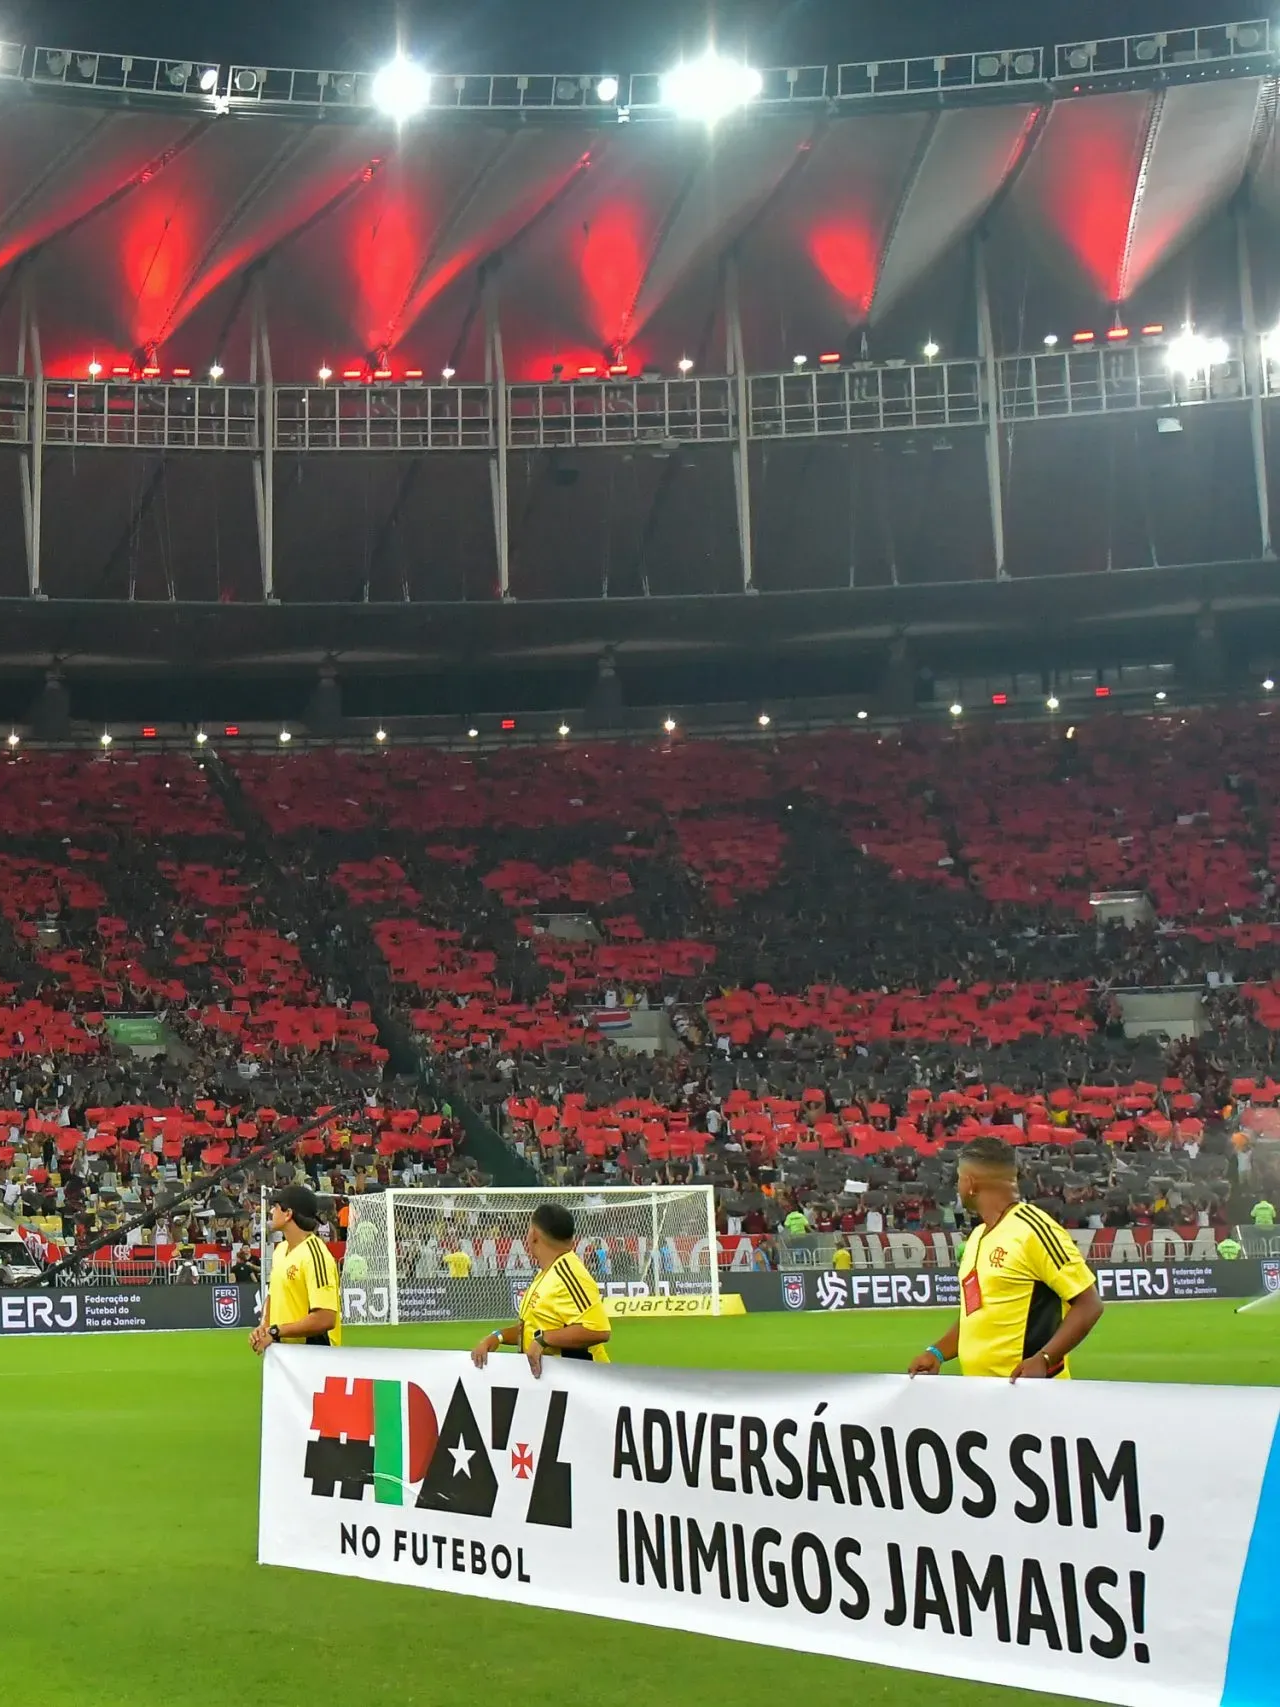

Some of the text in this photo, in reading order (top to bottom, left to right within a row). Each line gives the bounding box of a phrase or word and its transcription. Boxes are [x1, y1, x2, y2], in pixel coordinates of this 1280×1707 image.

[215, 1288, 237, 1297] FERJ
[852, 1275, 931, 1304] FERJ
[1097, 1268, 1169, 1297] FERJ
[84, 1294, 141, 1305] Federação de
[85, 1305, 129, 1315] Futebol do
[86, 1316, 146, 1326] Rio de Janeiro
[612, 1401, 1166, 1551] ADVERSÁRIOS SIM,
[340, 1522, 531, 1583] NO FUTEBOL
[616, 1507, 1152, 1664] INIMIGOS JAMAIS!
